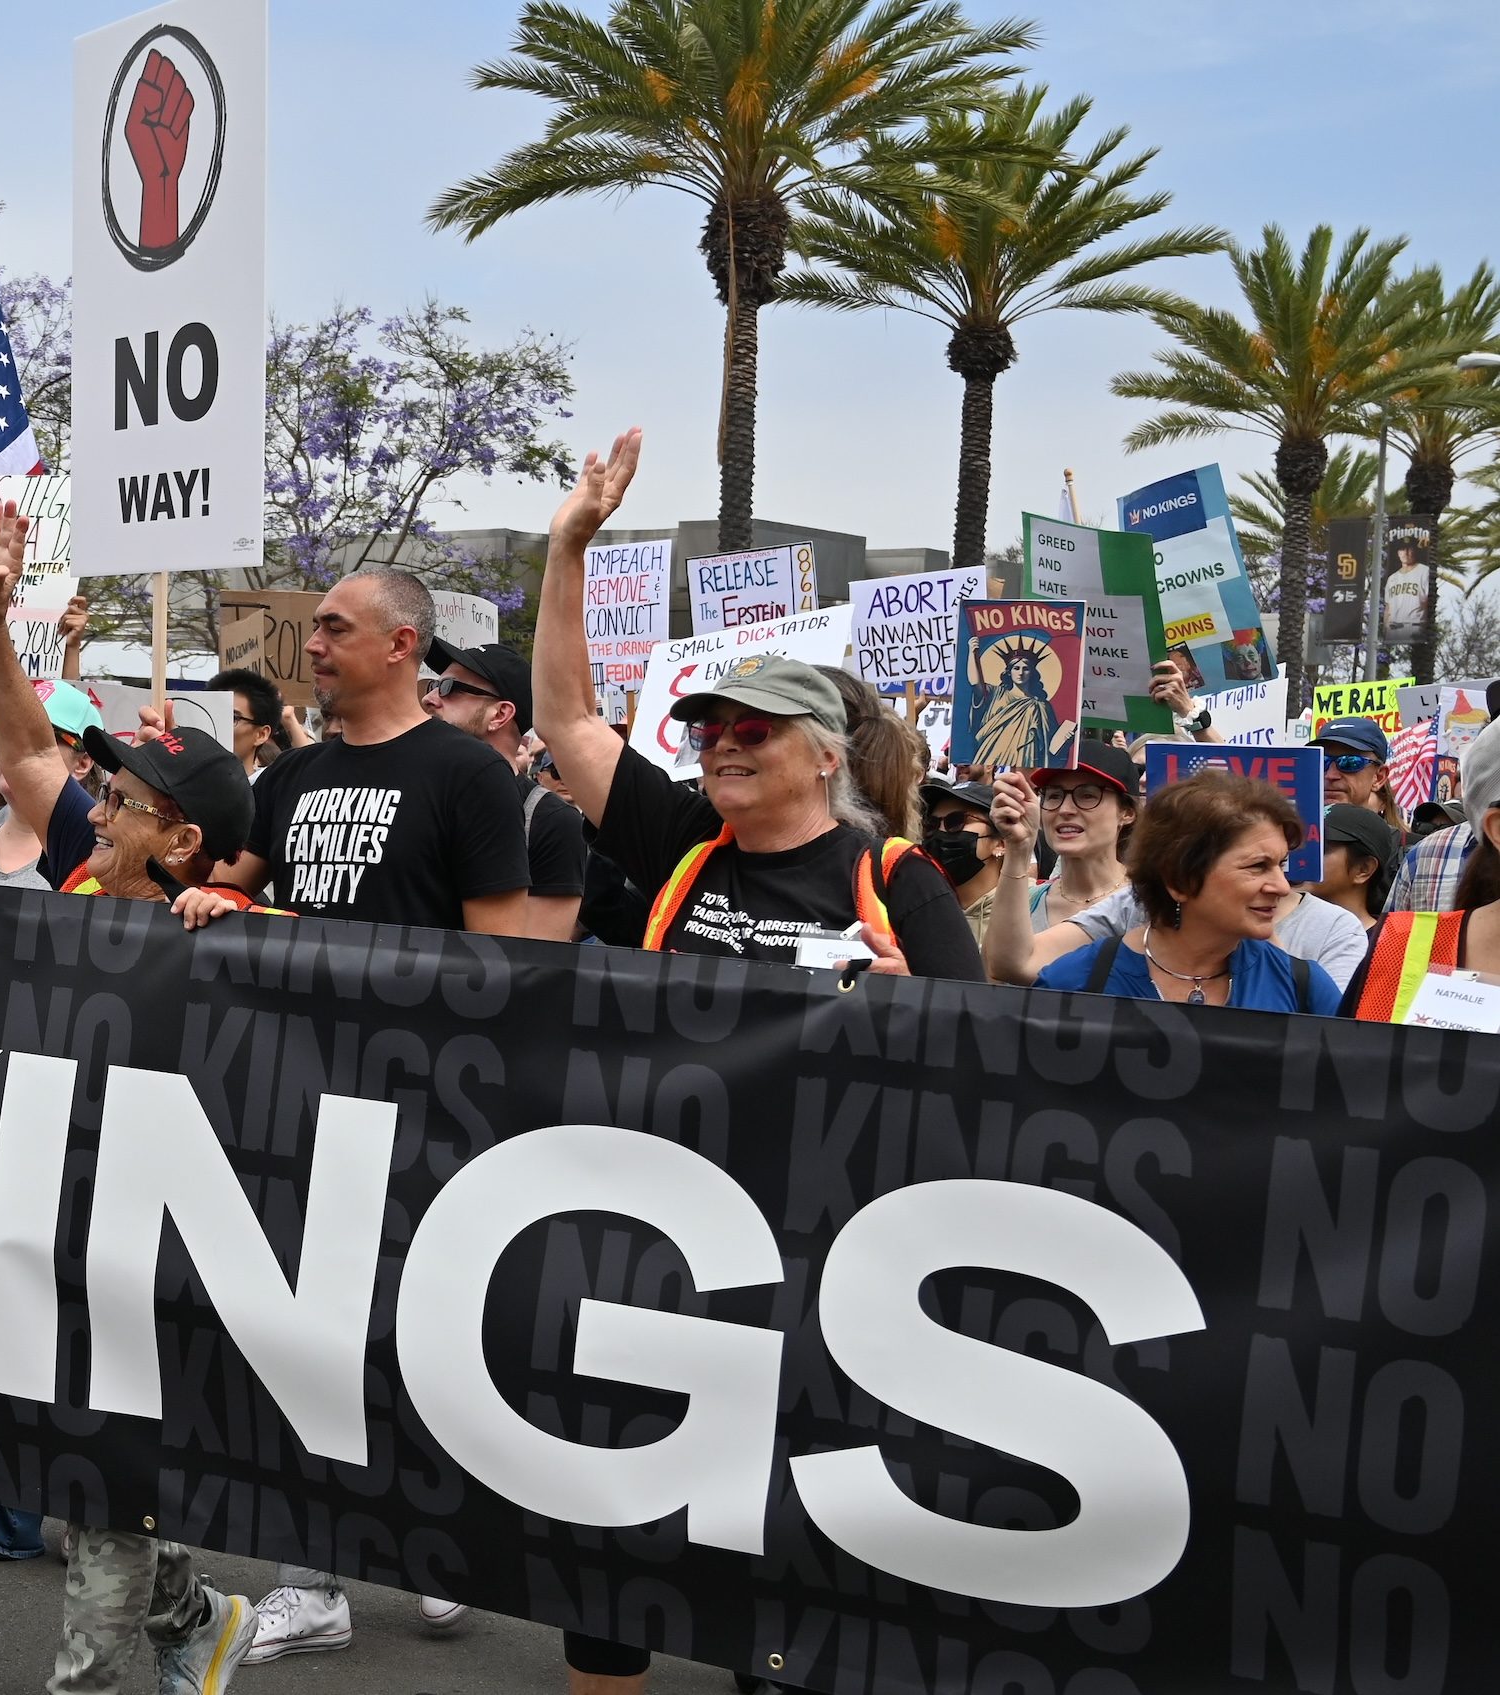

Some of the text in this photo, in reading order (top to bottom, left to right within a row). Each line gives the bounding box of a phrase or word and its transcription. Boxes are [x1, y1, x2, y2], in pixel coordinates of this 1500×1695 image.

[114, 321, 219, 431] NO
[118, 467, 210, 524] WAY!
[1142, 492, 1197, 520] NO KINGS
[1038, 533, 1075, 552] GREED
[27, 561, 70, 574] MATTER!
[698, 557, 778, 595] RELEASE
[1038, 557, 1062, 572] AND
[1156, 562, 1225, 595] CROWNS
[868, 578, 954, 619] ABORT
[1039, 580, 1068, 596] HATE
[434, 596, 495, 637] ought for my
[585, 602, 661, 639] CONVICT
[699, 601, 719, 621] The
[973, 604, 1076, 632] NO KINGS
[1086, 606, 1118, 619] WILL
[667, 615, 830, 662] SMALL DICKTATOR
[857, 614, 955, 647] UNWANTE
[1085, 626, 1115, 639] NOT
[589, 643, 613, 657] THE
[1089, 646, 1129, 659] MAKE
[605, 663, 644, 683] FELON
[1092, 666, 1120, 678] U.S.
[1316, 690, 1343, 716] WE
[291, 787, 402, 826] WORKING
[285, 823, 389, 864] FAMILIES
[290, 864, 366, 904] PARTY
[1435, 988, 1485, 1005] NATHALIE
[1256, 1135, 1487, 1337] NO
[1236, 1333, 1465, 1535] NO
[1229, 1525, 1451, 1695] NO
